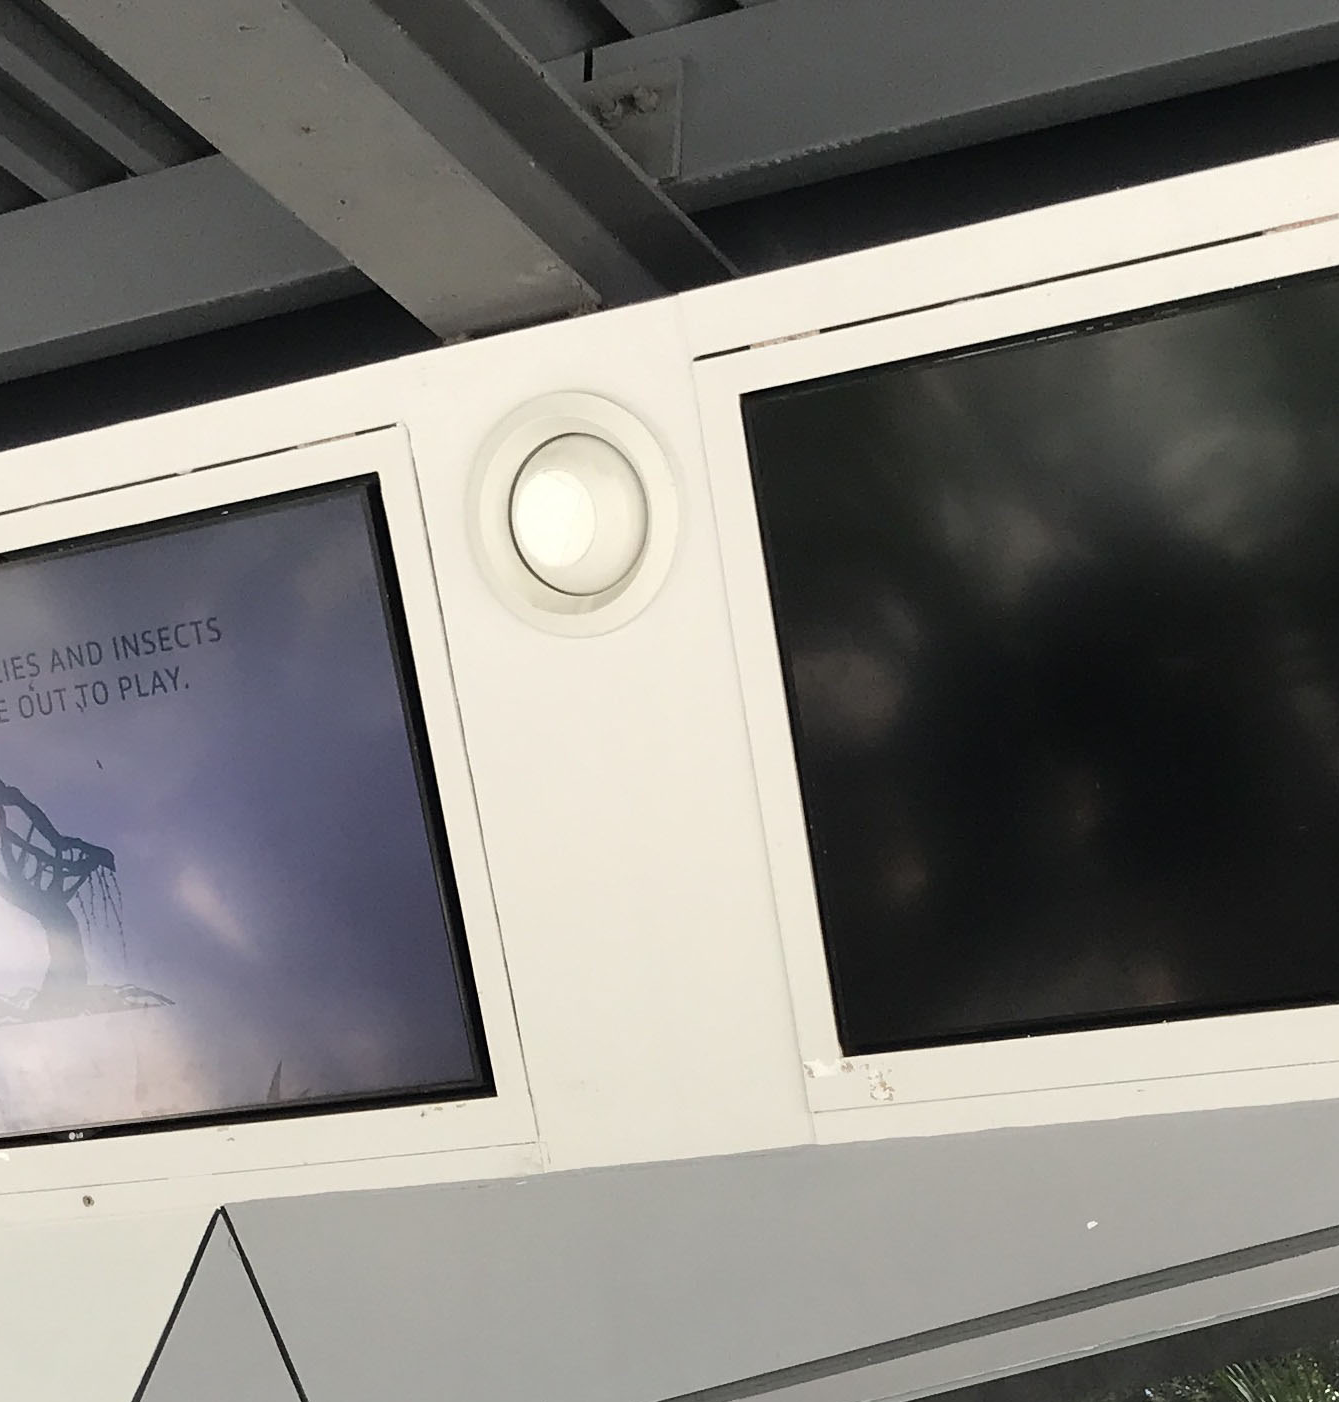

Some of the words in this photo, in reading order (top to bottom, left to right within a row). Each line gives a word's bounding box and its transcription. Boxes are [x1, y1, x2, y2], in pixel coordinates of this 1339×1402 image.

[51, 641, 103, 673] AND
[112, 617, 222, 661] INSECTS
[19, 688, 67, 719] OUT
[75, 680, 109, 708] TO
[118, 665, 189, 701] PLAY.
